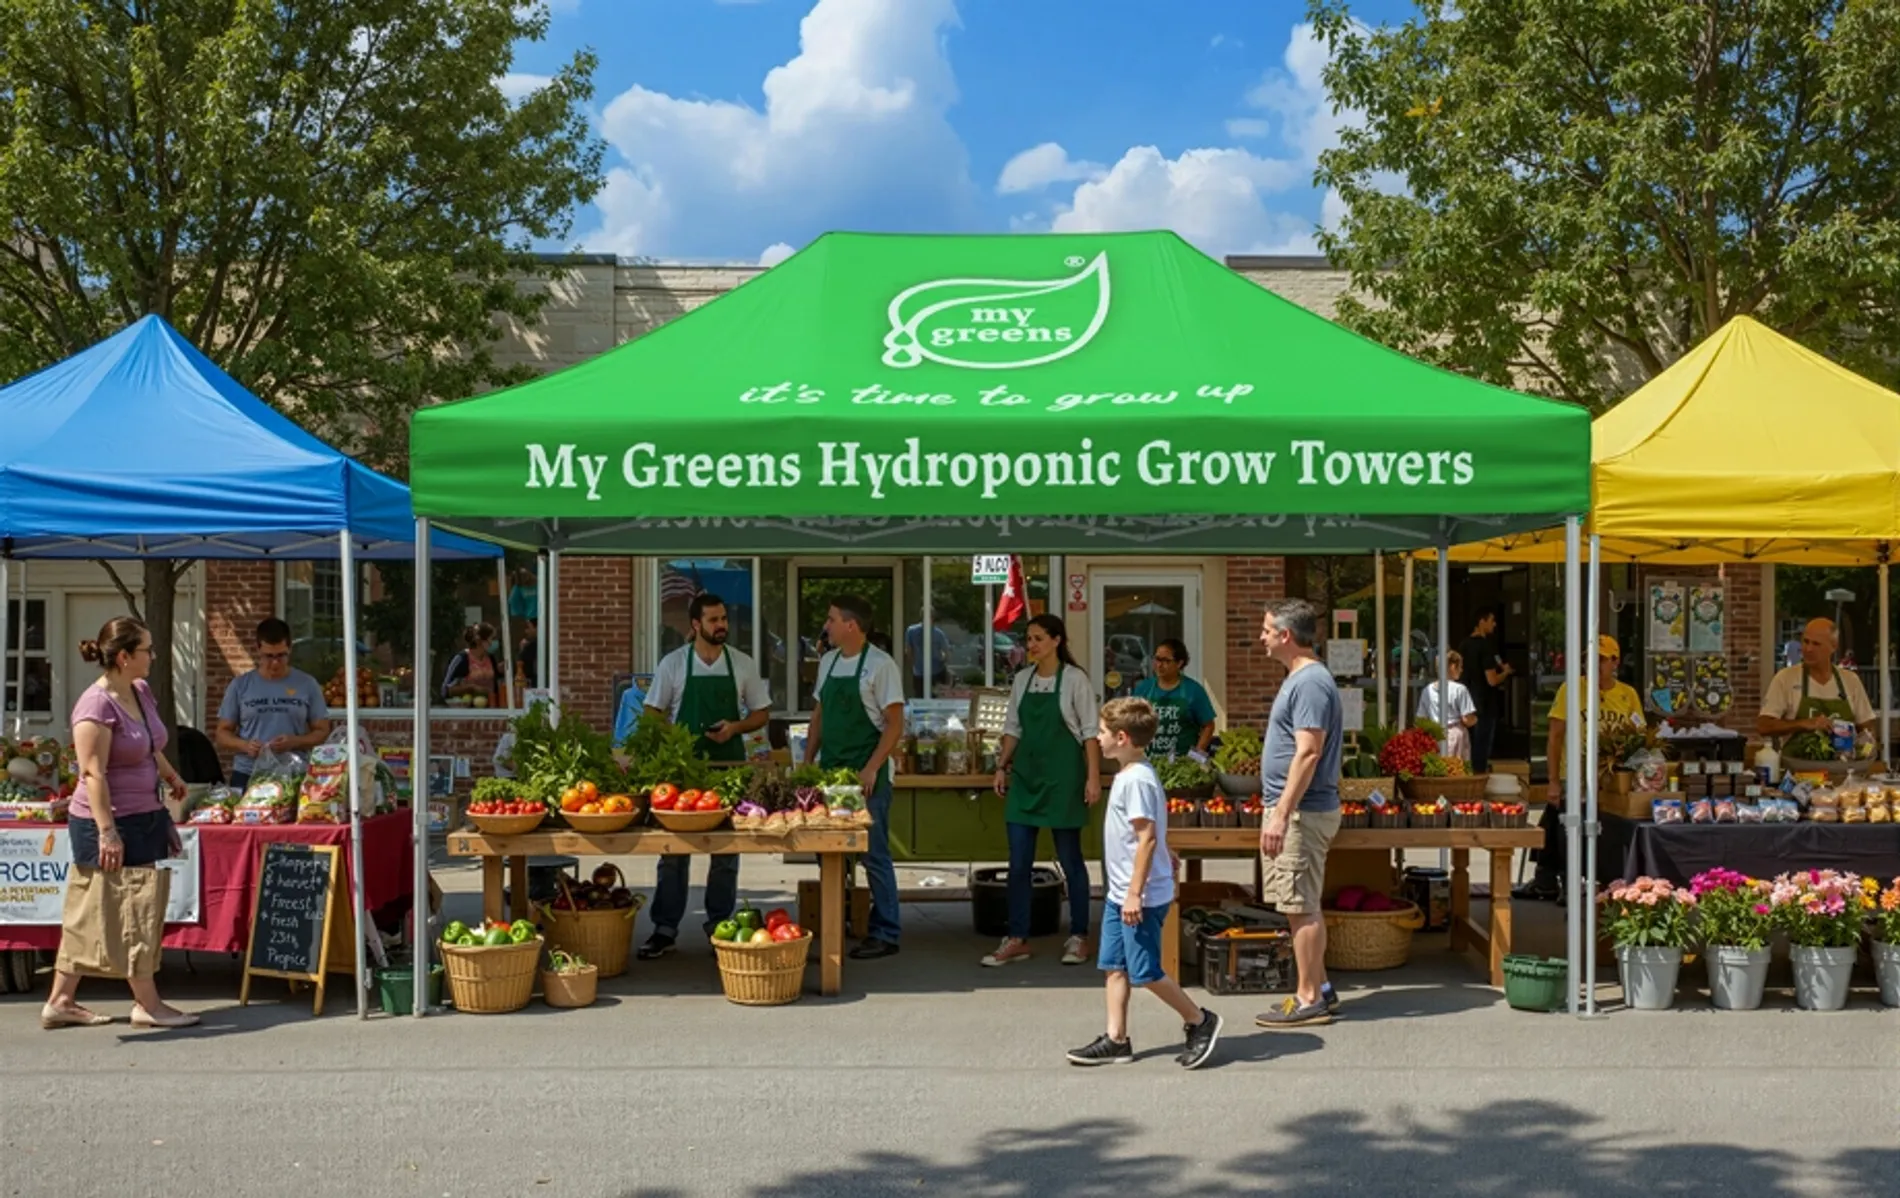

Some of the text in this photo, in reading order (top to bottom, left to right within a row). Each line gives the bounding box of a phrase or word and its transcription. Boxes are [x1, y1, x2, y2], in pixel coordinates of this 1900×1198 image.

[969, 306, 1035, 327] my
[931, 322, 1073, 346] greens
[739, 381, 1255, 412] it's time to grow up
[524, 437, 1475, 500] My Greens Hydroponic Grow Towers
